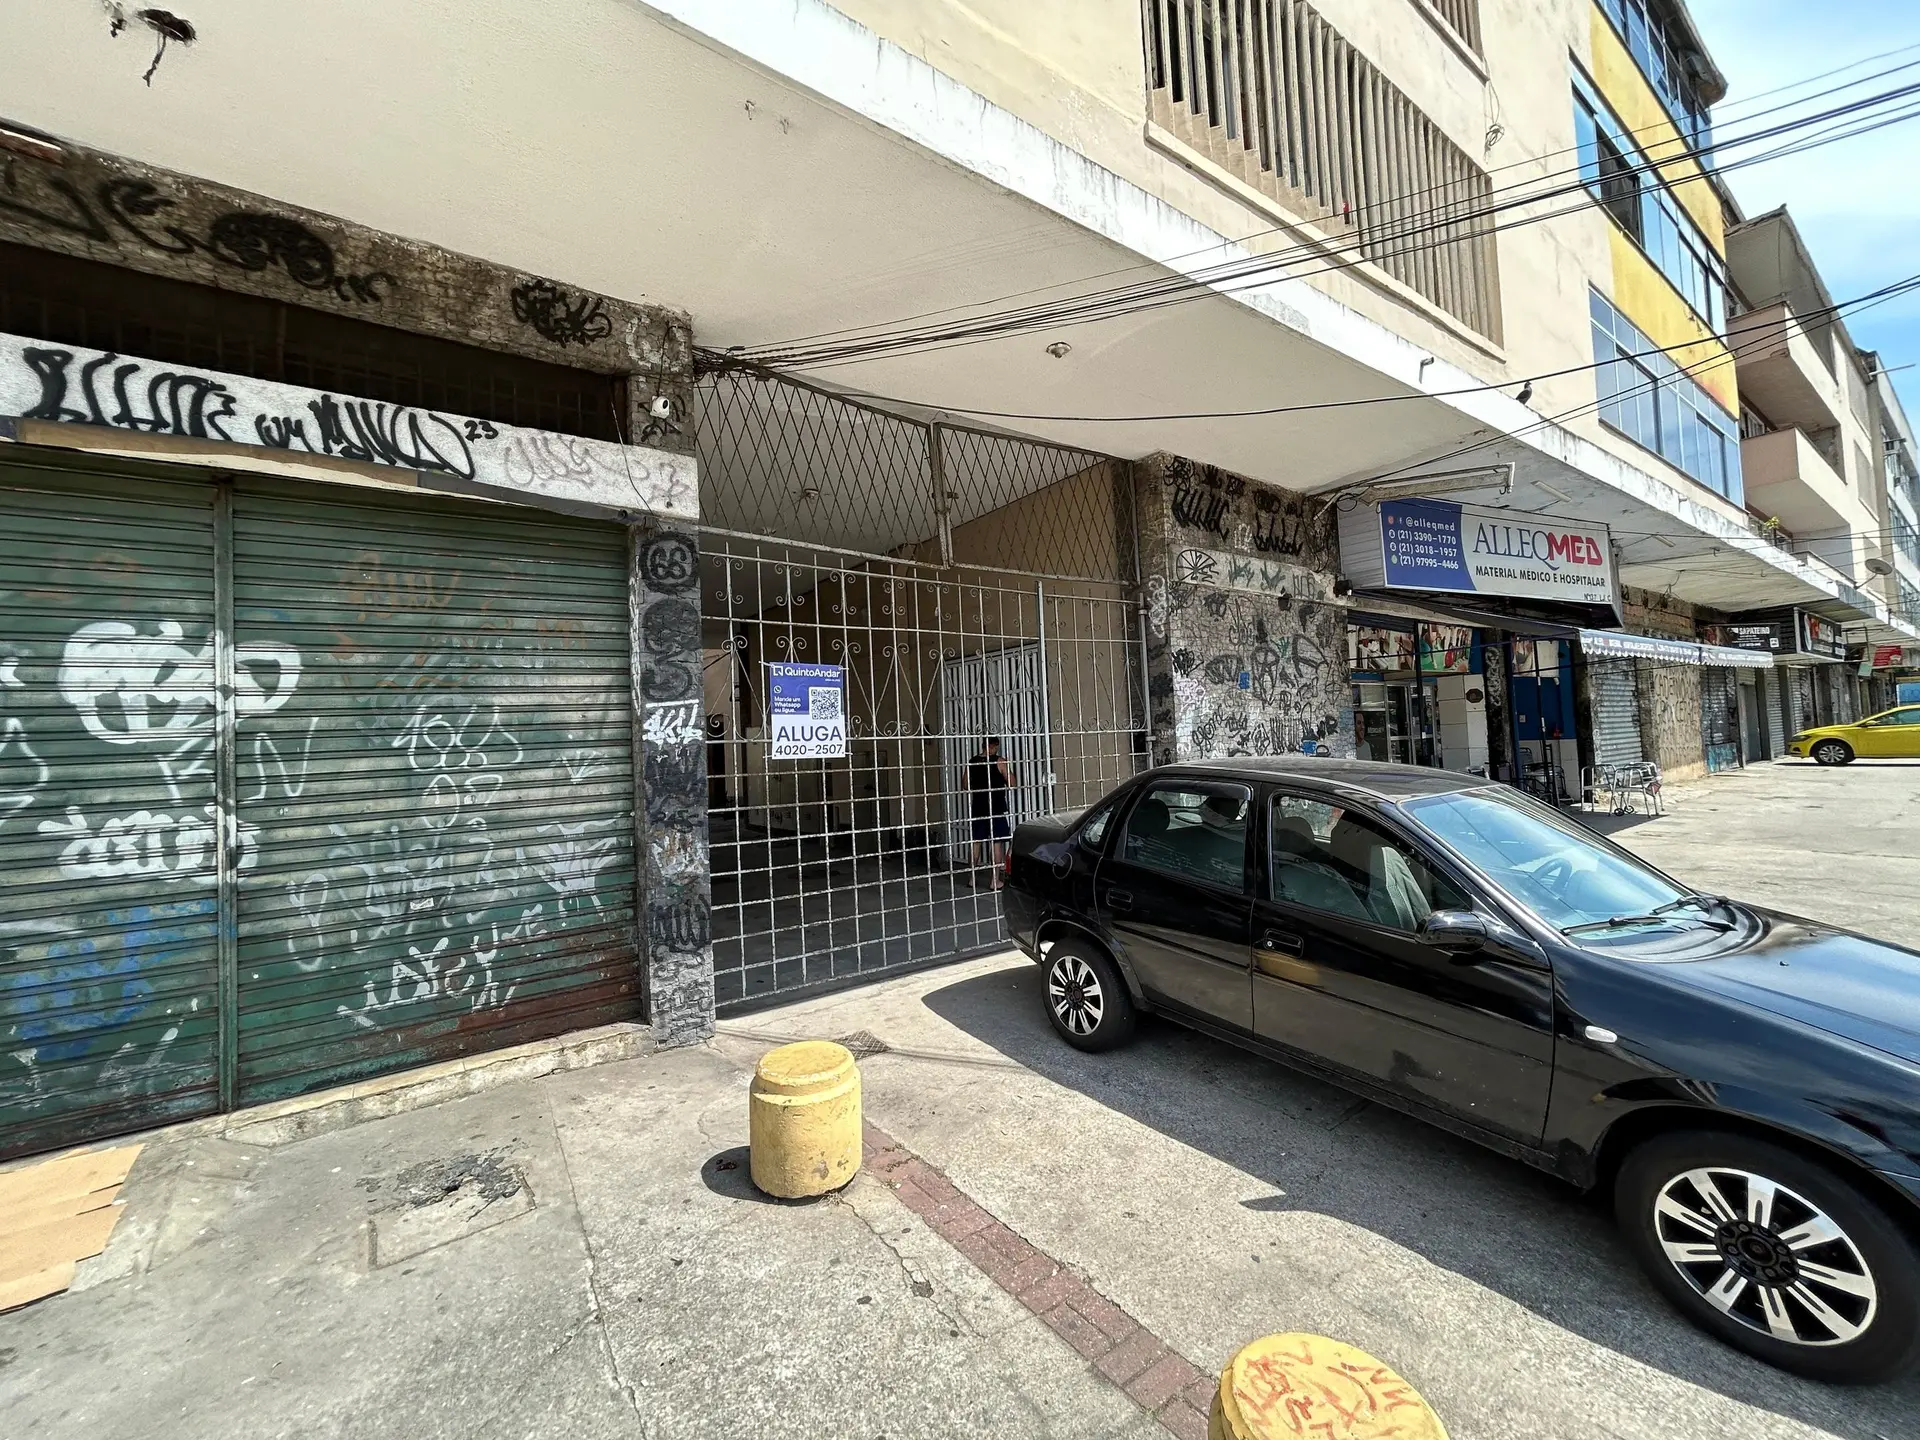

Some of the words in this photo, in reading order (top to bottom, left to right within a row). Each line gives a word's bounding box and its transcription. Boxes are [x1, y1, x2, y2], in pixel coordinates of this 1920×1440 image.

[1405, 516, 1455, 531] @alleqmed
[1397, 530, 1412, 542] (21)
[1413, 532, 1457, 545] 3390-1770
[1399, 542, 1413, 555] (21)
[1414, 544, 1457, 557] 3018-1957
[1473, 522, 1603, 571] ALLEQMED
[1475, 565, 1518, 579] MATERIAL
[1519, 568, 1551, 583] MÉDICO
[1553, 573, 1558, 583] E
[1560, 574, 1606, 588] HOSPITALAR
[784, 667, 841, 678] QuintoAndar
[776, 726, 843, 742] ALUGA
[775, 744, 843, 756] 4020-2507
